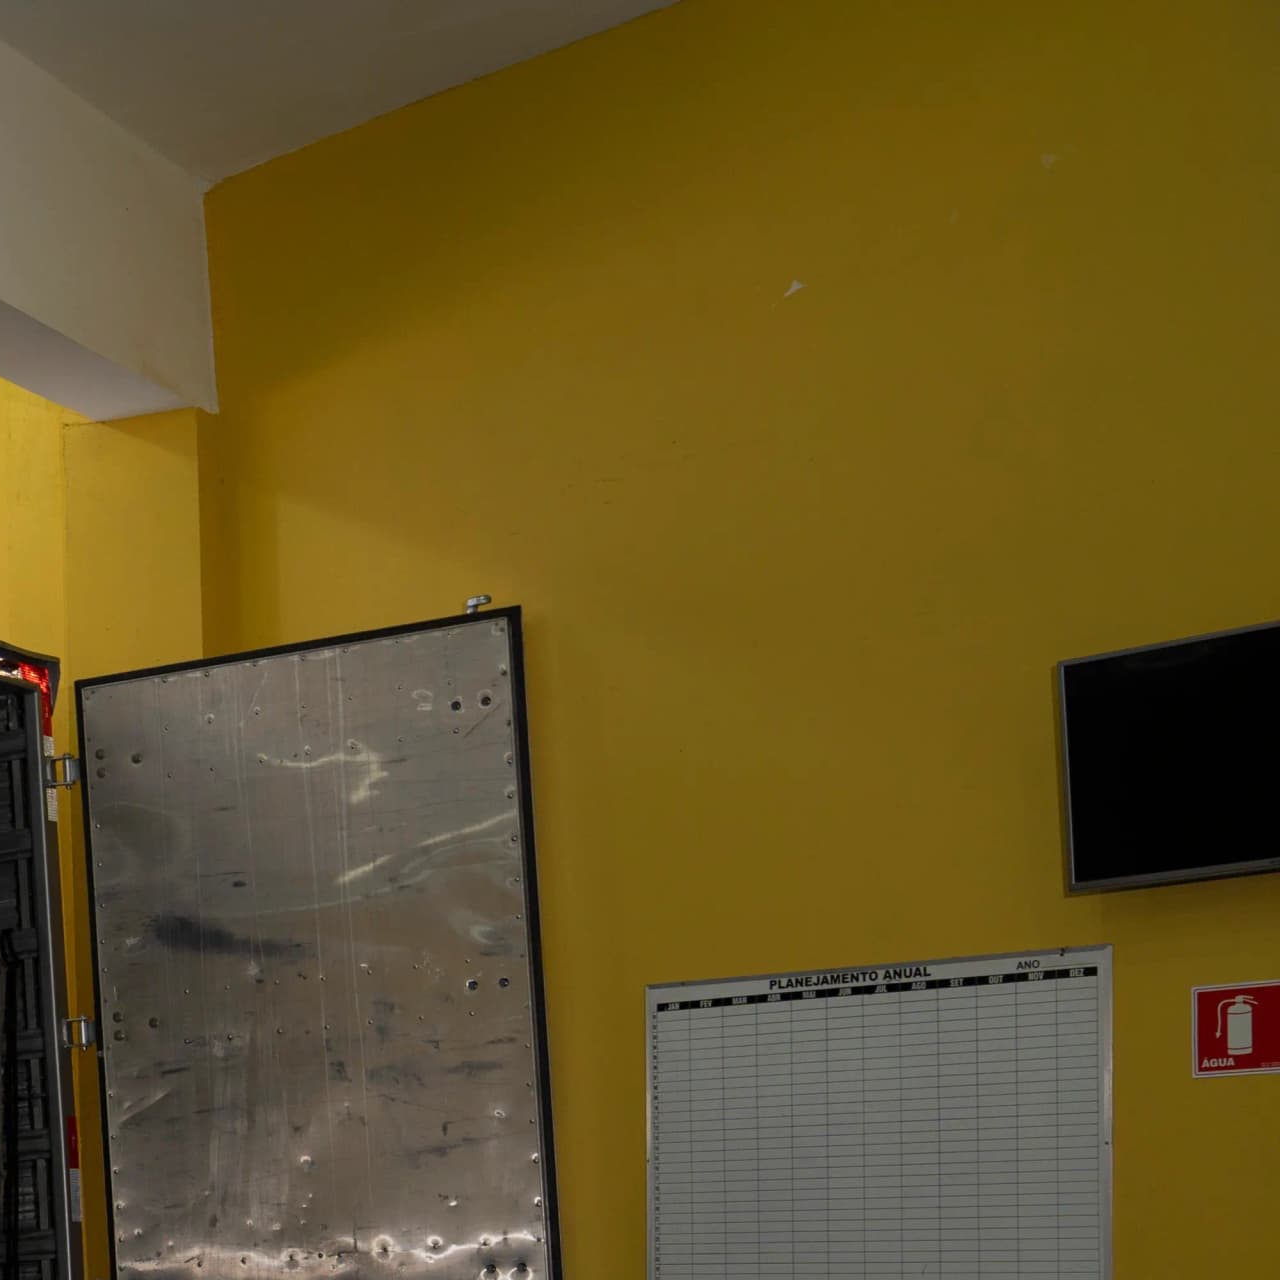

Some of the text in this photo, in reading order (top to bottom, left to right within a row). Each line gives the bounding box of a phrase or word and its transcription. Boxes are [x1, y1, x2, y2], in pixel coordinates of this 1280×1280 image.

[1016, 960, 1040, 970] ANO
[769, 967, 931, 990] PLANEJAMENTO ANUAL
